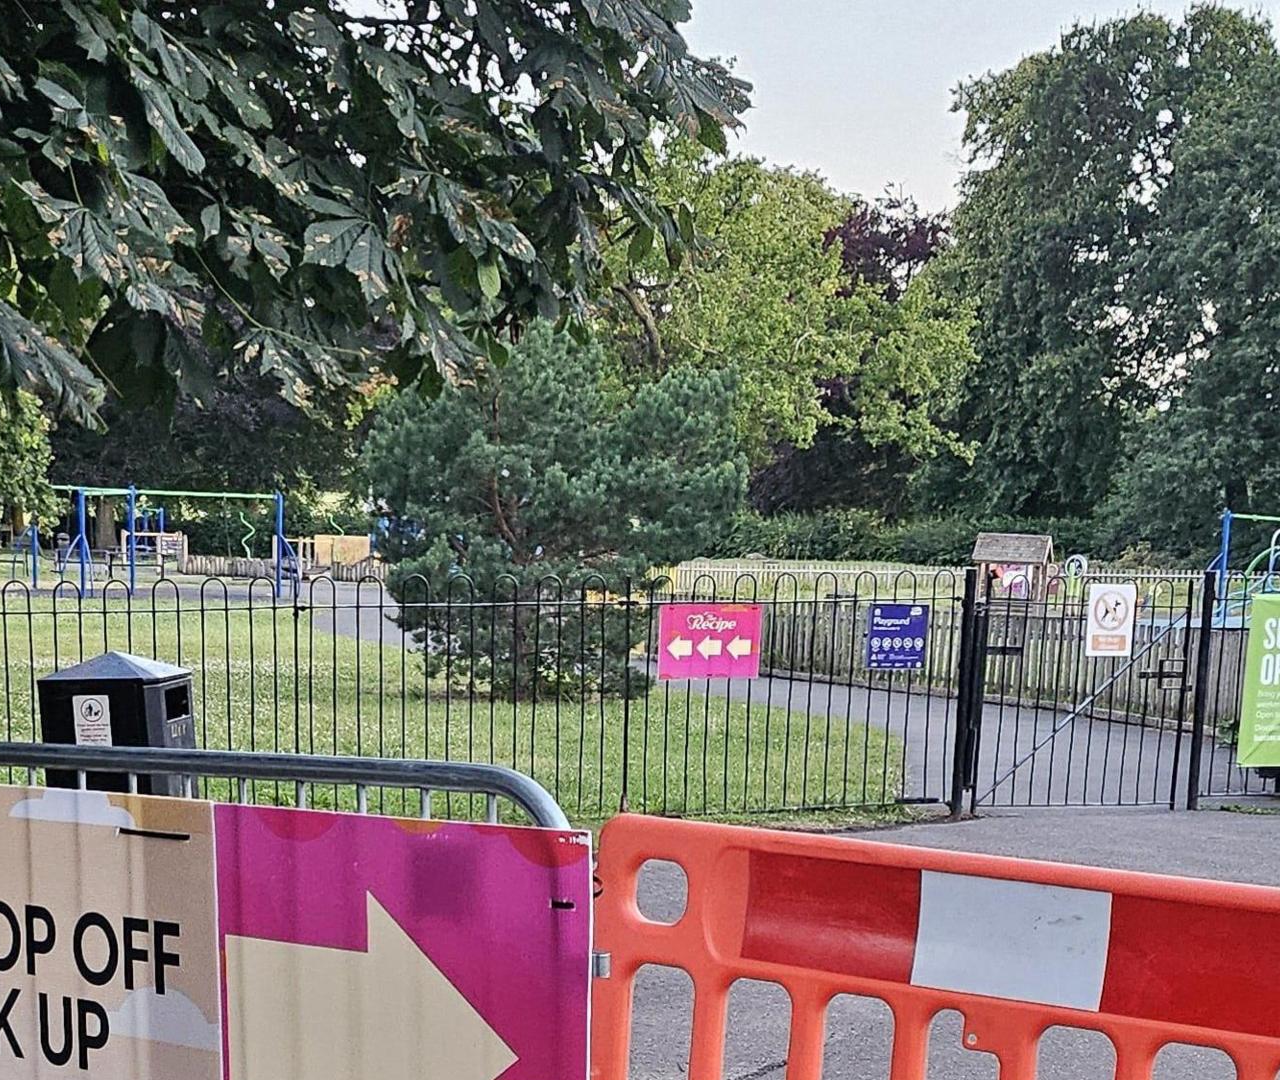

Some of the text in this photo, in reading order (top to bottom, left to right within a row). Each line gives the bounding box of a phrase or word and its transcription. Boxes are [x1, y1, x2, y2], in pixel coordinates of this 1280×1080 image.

[687, 613, 737, 633] Recipe
[72, 911, 181, 996] OFF
[38, 992, 110, 1070] UP
